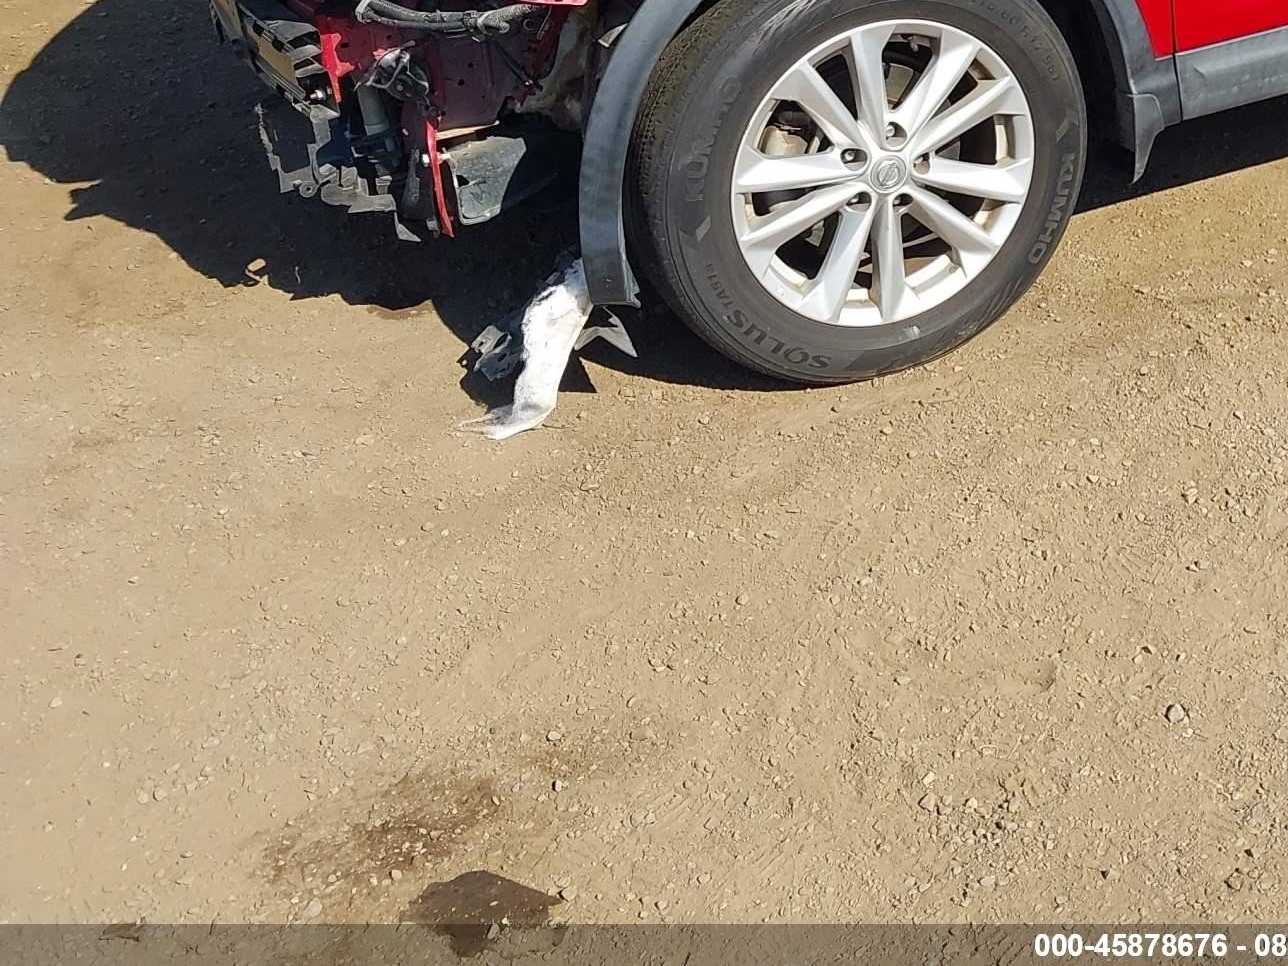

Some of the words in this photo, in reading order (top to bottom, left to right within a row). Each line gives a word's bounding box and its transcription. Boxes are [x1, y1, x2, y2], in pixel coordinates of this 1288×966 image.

[684, 77, 742, 202] KUMHO
[1028, 151, 1077, 265] KUMHO
[727, 309, 832, 369] SOLUS
